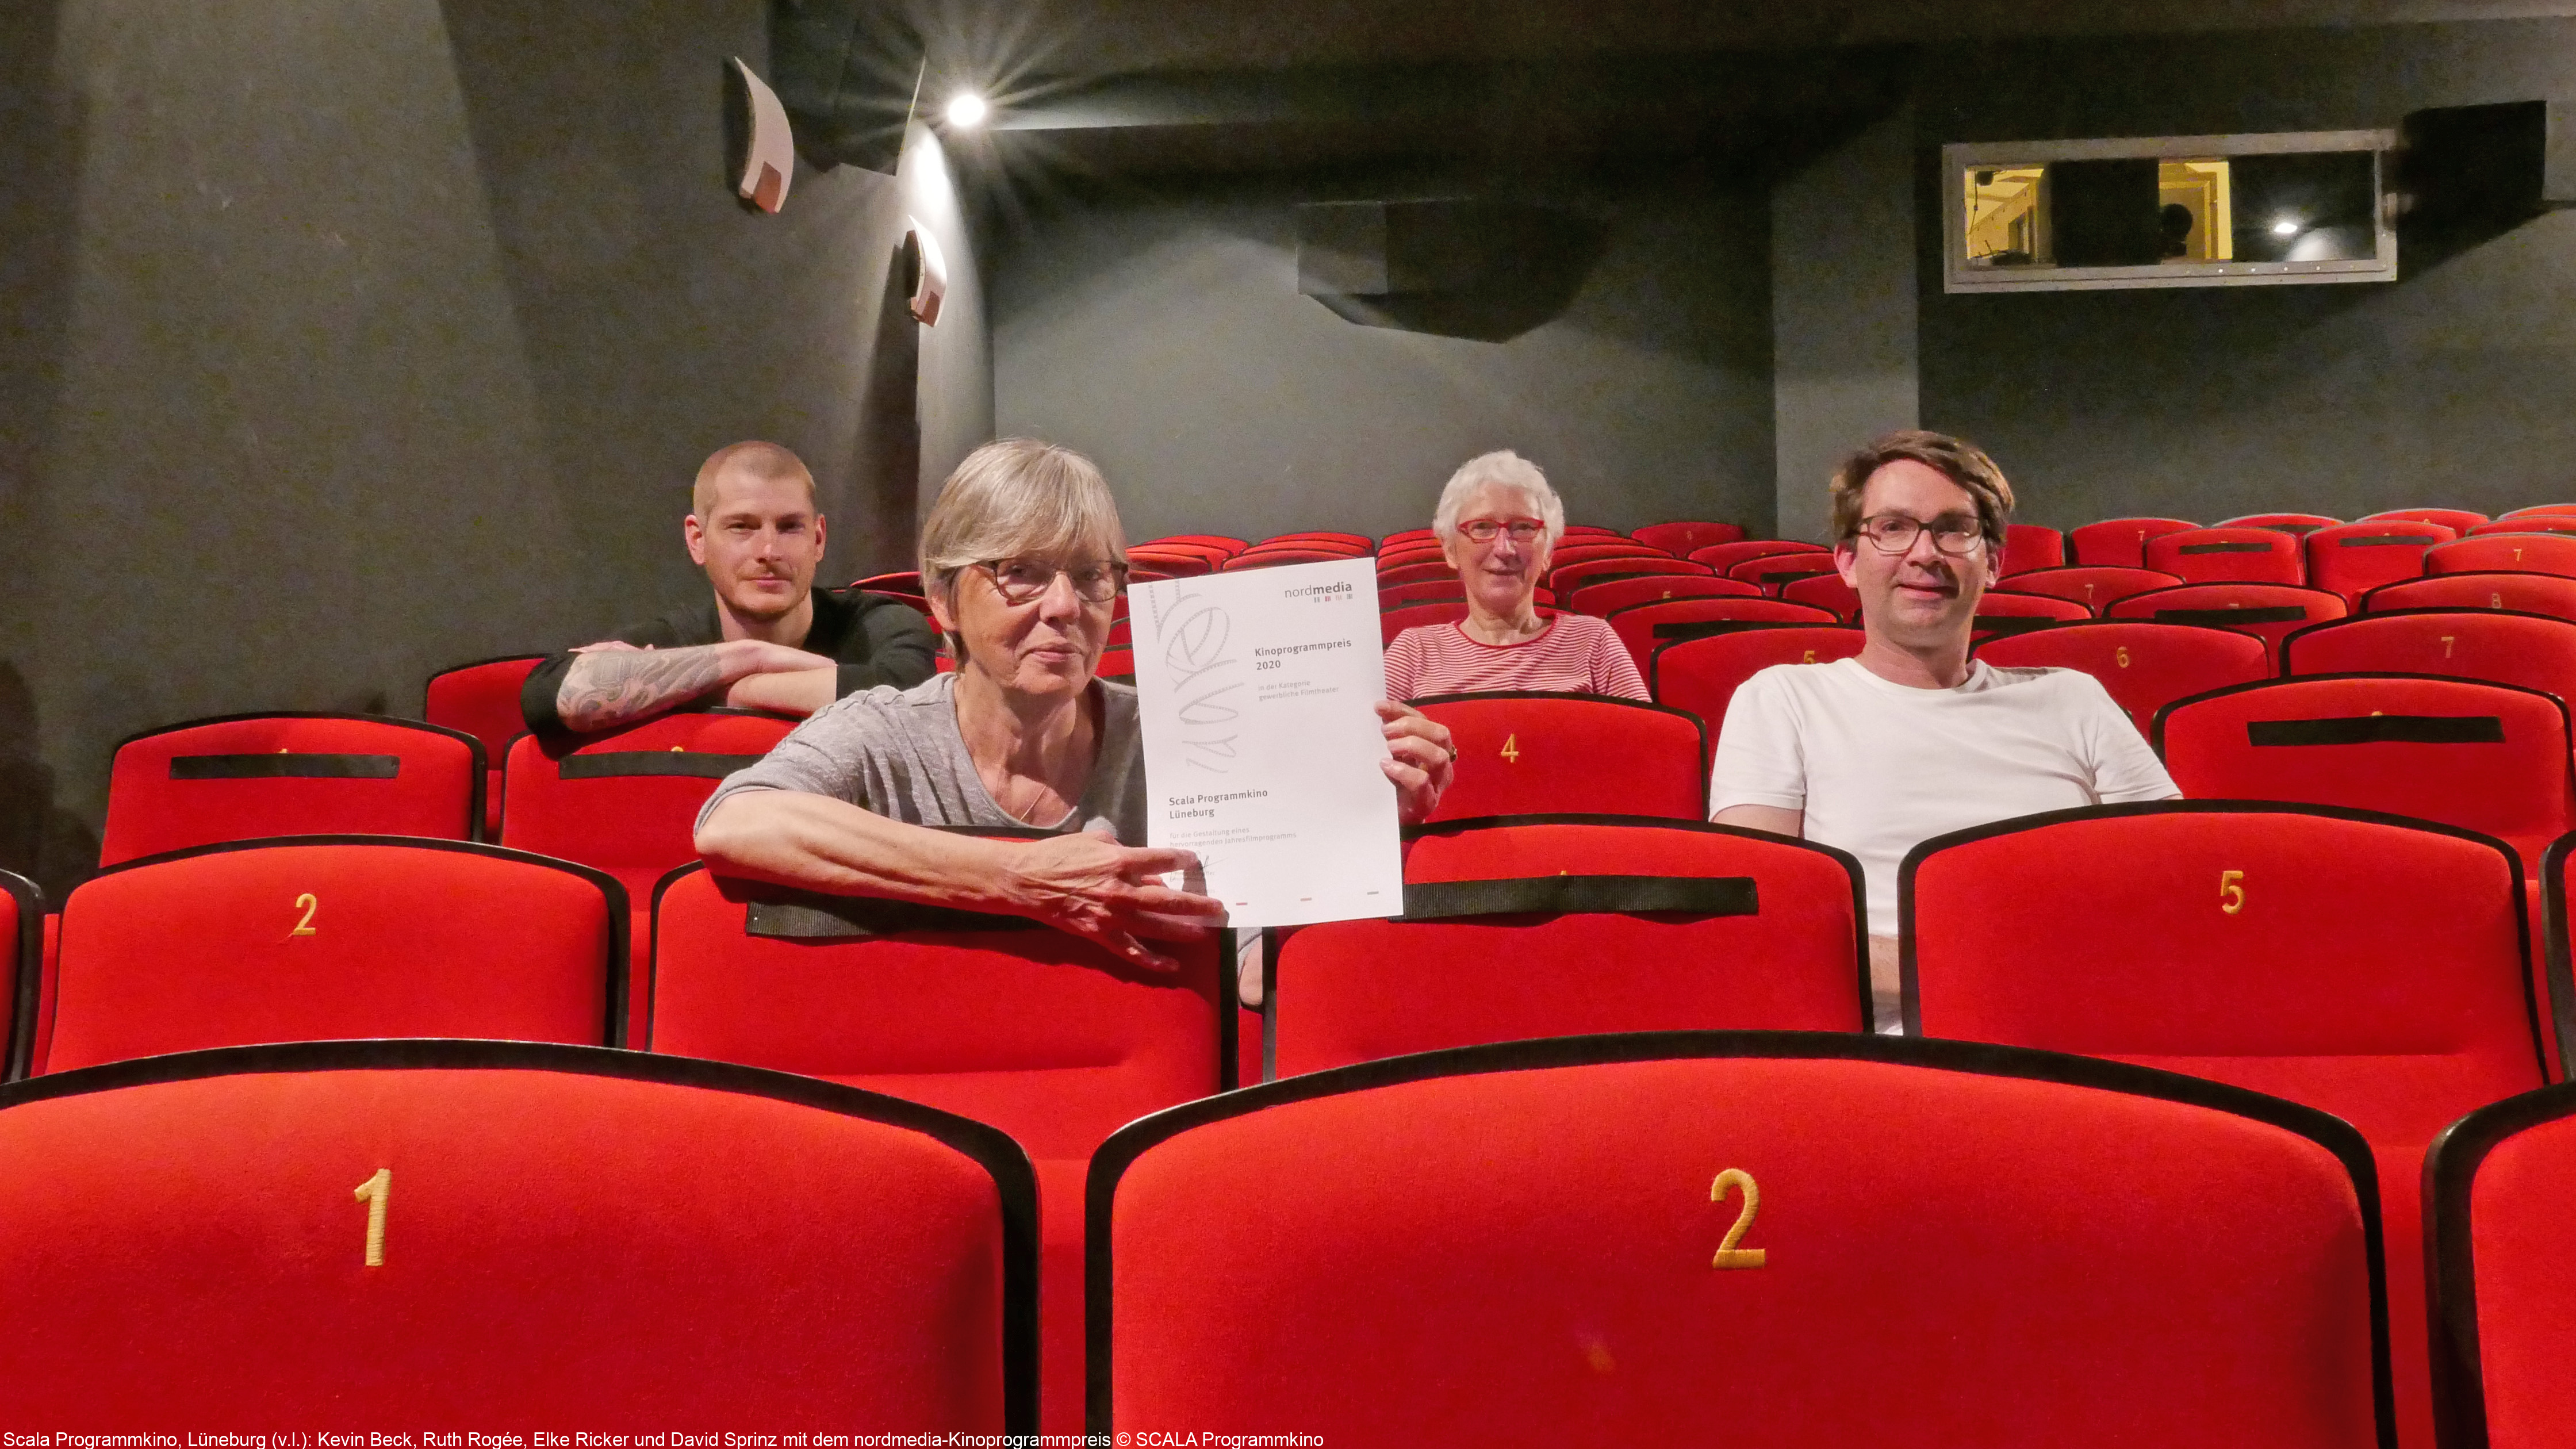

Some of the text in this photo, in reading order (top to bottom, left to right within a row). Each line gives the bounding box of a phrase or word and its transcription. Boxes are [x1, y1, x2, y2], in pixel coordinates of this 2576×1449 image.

[2513, 548, 2523, 562] 7
[1285, 581, 1352, 598] nordmedia
[2084, 584, 2094, 599] 7
[1255, 638, 1352, 657] Kinoprogrammpreis
[2440, 635, 2455, 659] 7
[1256, 660, 1281, 670] 2020
[1803, 650, 1816, 664] 5
[2116, 646, 2130, 669] 6
[1278, 680, 1310, 689] Kategorie
[1259, 687, 1339, 702] gewerbliche Filmtheater
[1500, 733, 1520, 763] 4
[1169, 788, 1268, 806] Scala Programmkino
[1170, 808, 1215, 819] Lüneburg
[1170, 832, 1297, 848] hervorragenden Jahresfilmprogramms
[1193, 829, 1230, 838] Gestaltung
[2220, 870, 2245, 915] 5
[291, 893, 317, 936] 2
[354, 1167, 392, 1267] 1
[1710, 1167, 1766, 1270] 2
